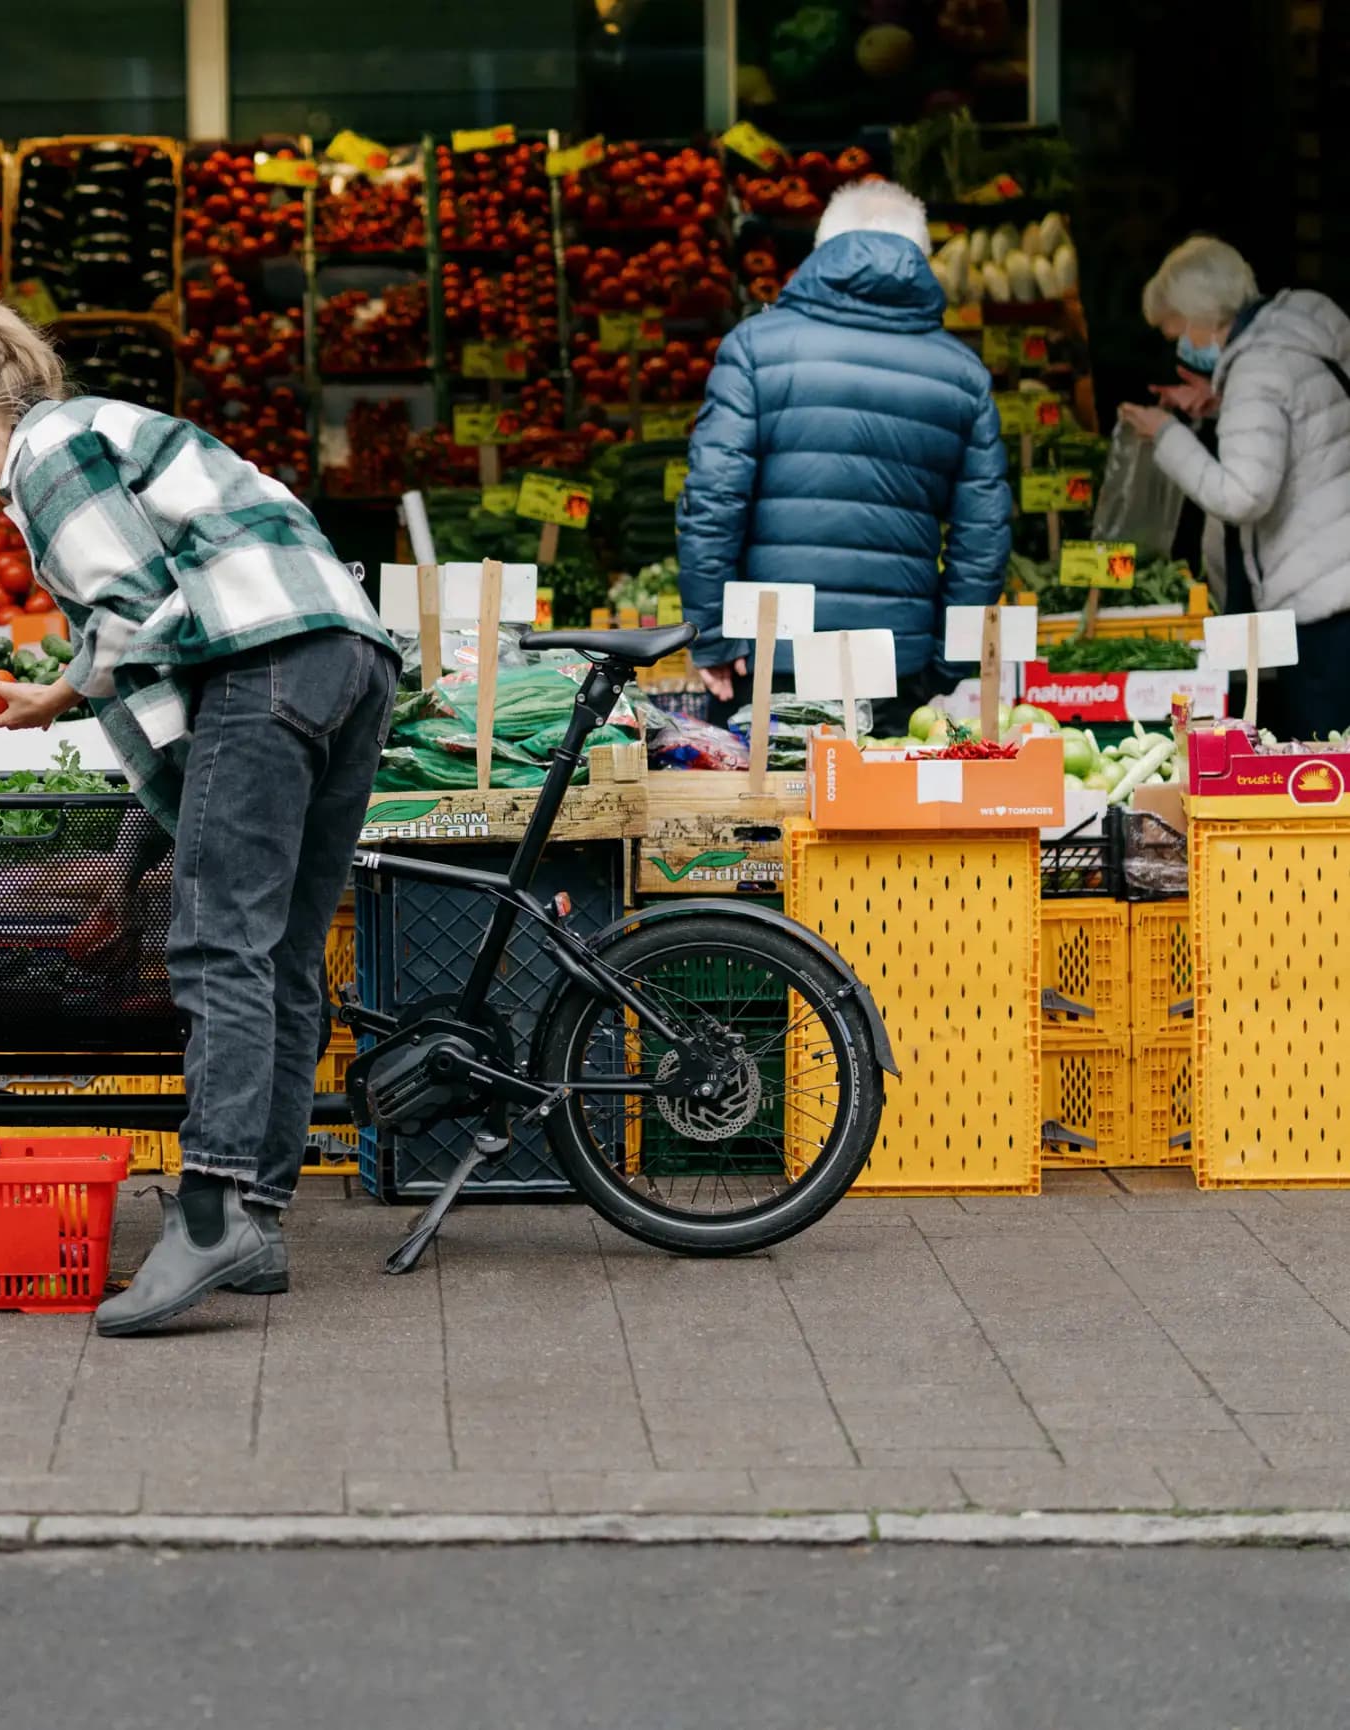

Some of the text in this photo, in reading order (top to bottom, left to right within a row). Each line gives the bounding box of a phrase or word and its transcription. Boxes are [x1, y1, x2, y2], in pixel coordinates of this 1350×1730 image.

[827, 748, 837, 801] CLASSICO
[1237, 772, 1284, 785] trust it
[980, 807, 1053, 816] WE TOMATOES
[430, 813, 488, 824] TARIM
[352, 852, 381, 870] uli
[647, 852, 784, 882] Verdican
[742, 862, 784, 872] TARIM
